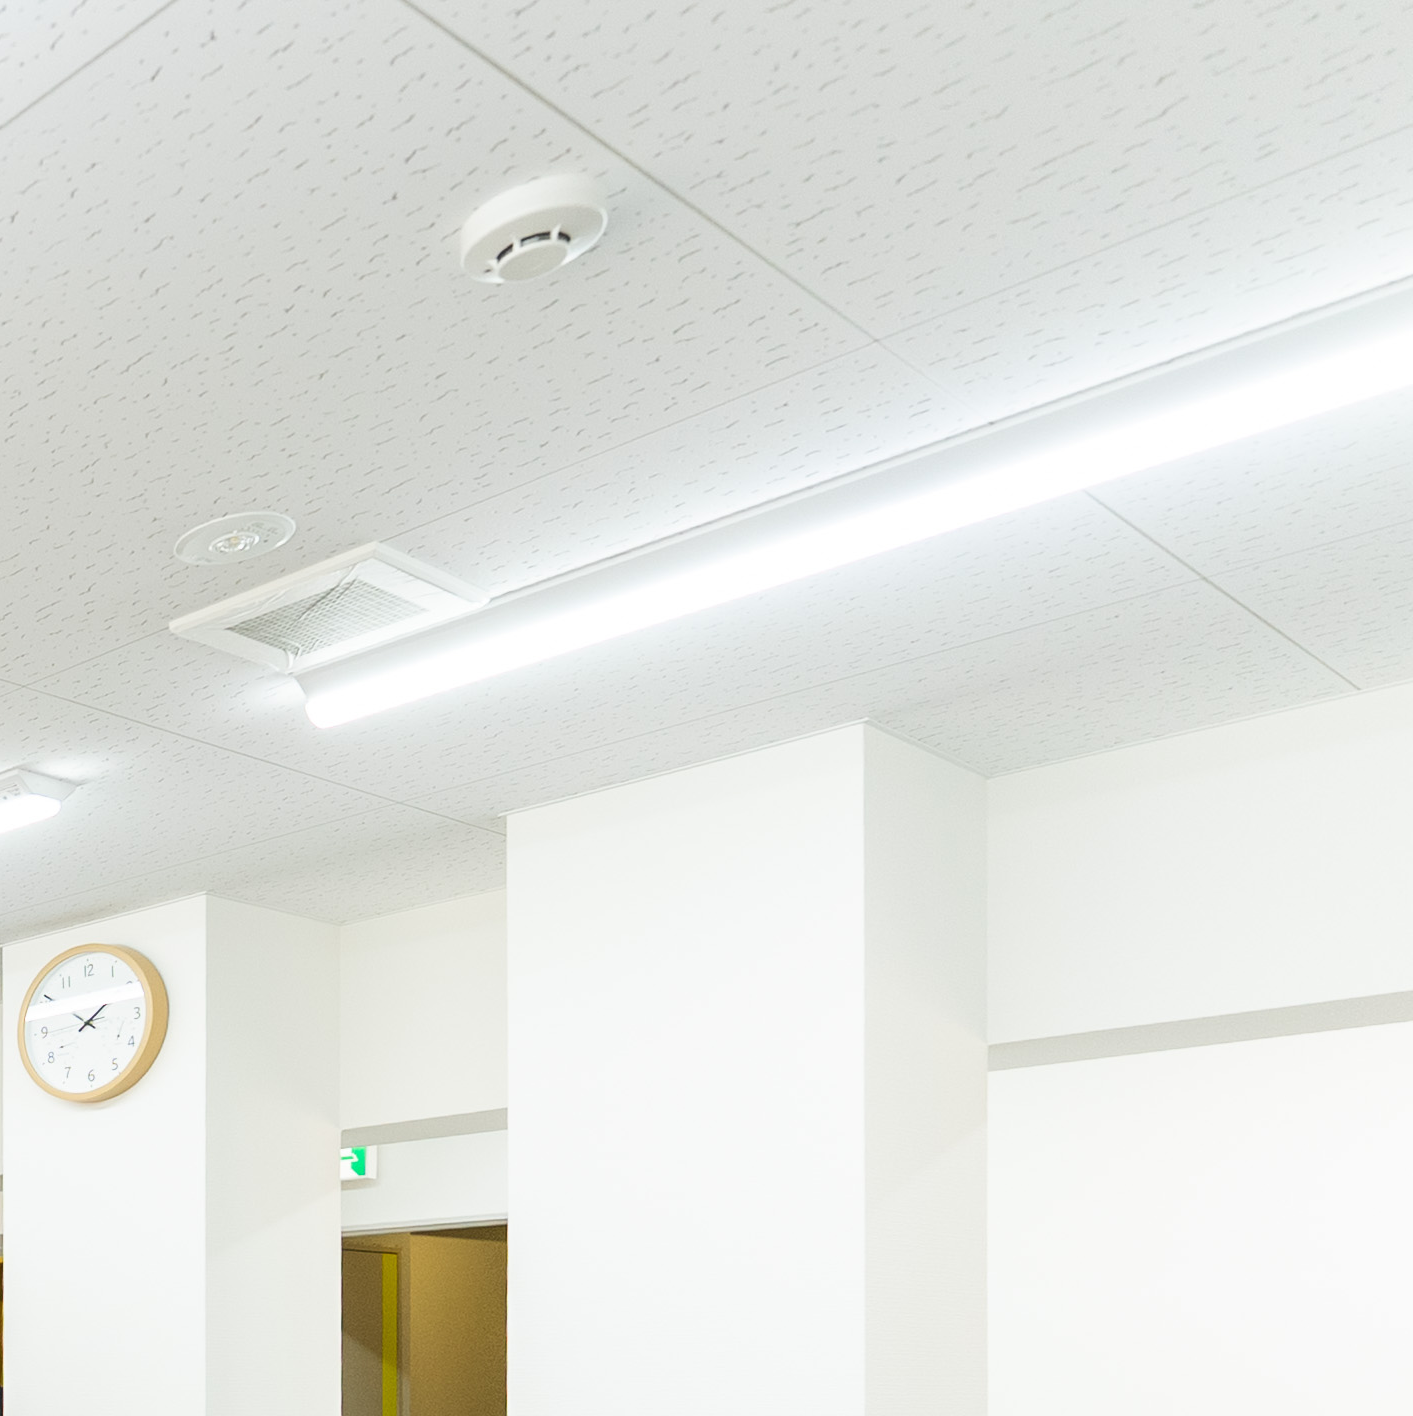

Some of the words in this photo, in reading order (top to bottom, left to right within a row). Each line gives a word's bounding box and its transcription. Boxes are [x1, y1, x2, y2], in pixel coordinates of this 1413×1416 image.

[84, 963, 95, 977] 12
[61, 976, 71, 989] 11
[133, 1007, 141, 1020] 3
[40, 1026, 48, 1039] 9
[127, 1035, 135, 1047] 4
[47, 1051, 55, 1064] 8
[111, 1057, 119, 1071] 5
[64, 1066, 71, 1079] 7
[87, 1069, 95, 1082] 6
